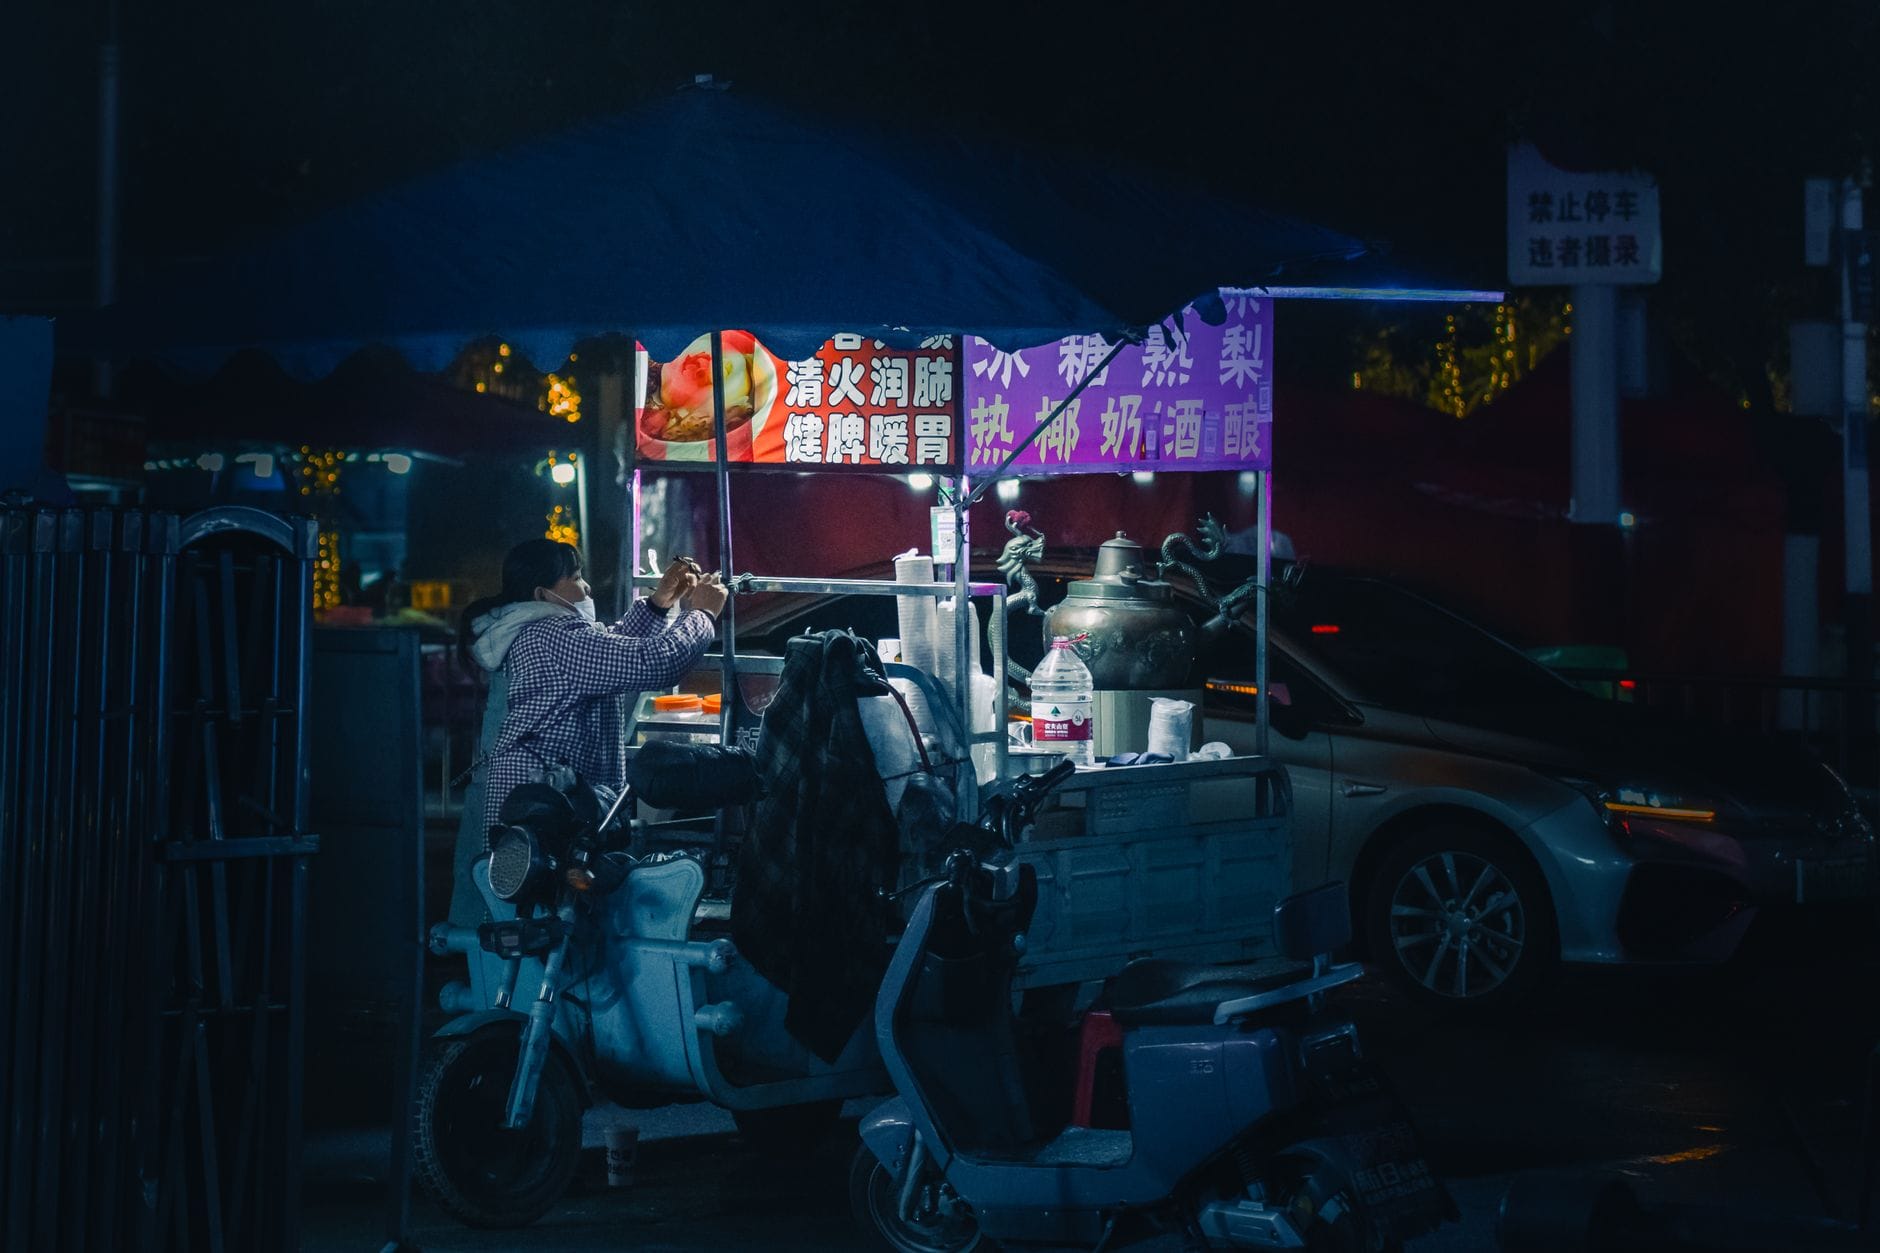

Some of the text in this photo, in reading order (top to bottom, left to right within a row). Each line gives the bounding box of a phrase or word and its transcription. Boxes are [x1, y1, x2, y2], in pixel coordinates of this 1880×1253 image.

[1528, 190, 1639, 223] 禁止停车
[1528, 234, 1639, 267] 违者摄录
[785, 356, 953, 408] 清火润肺
[783, 413, 952, 465] 健脾暖胃
